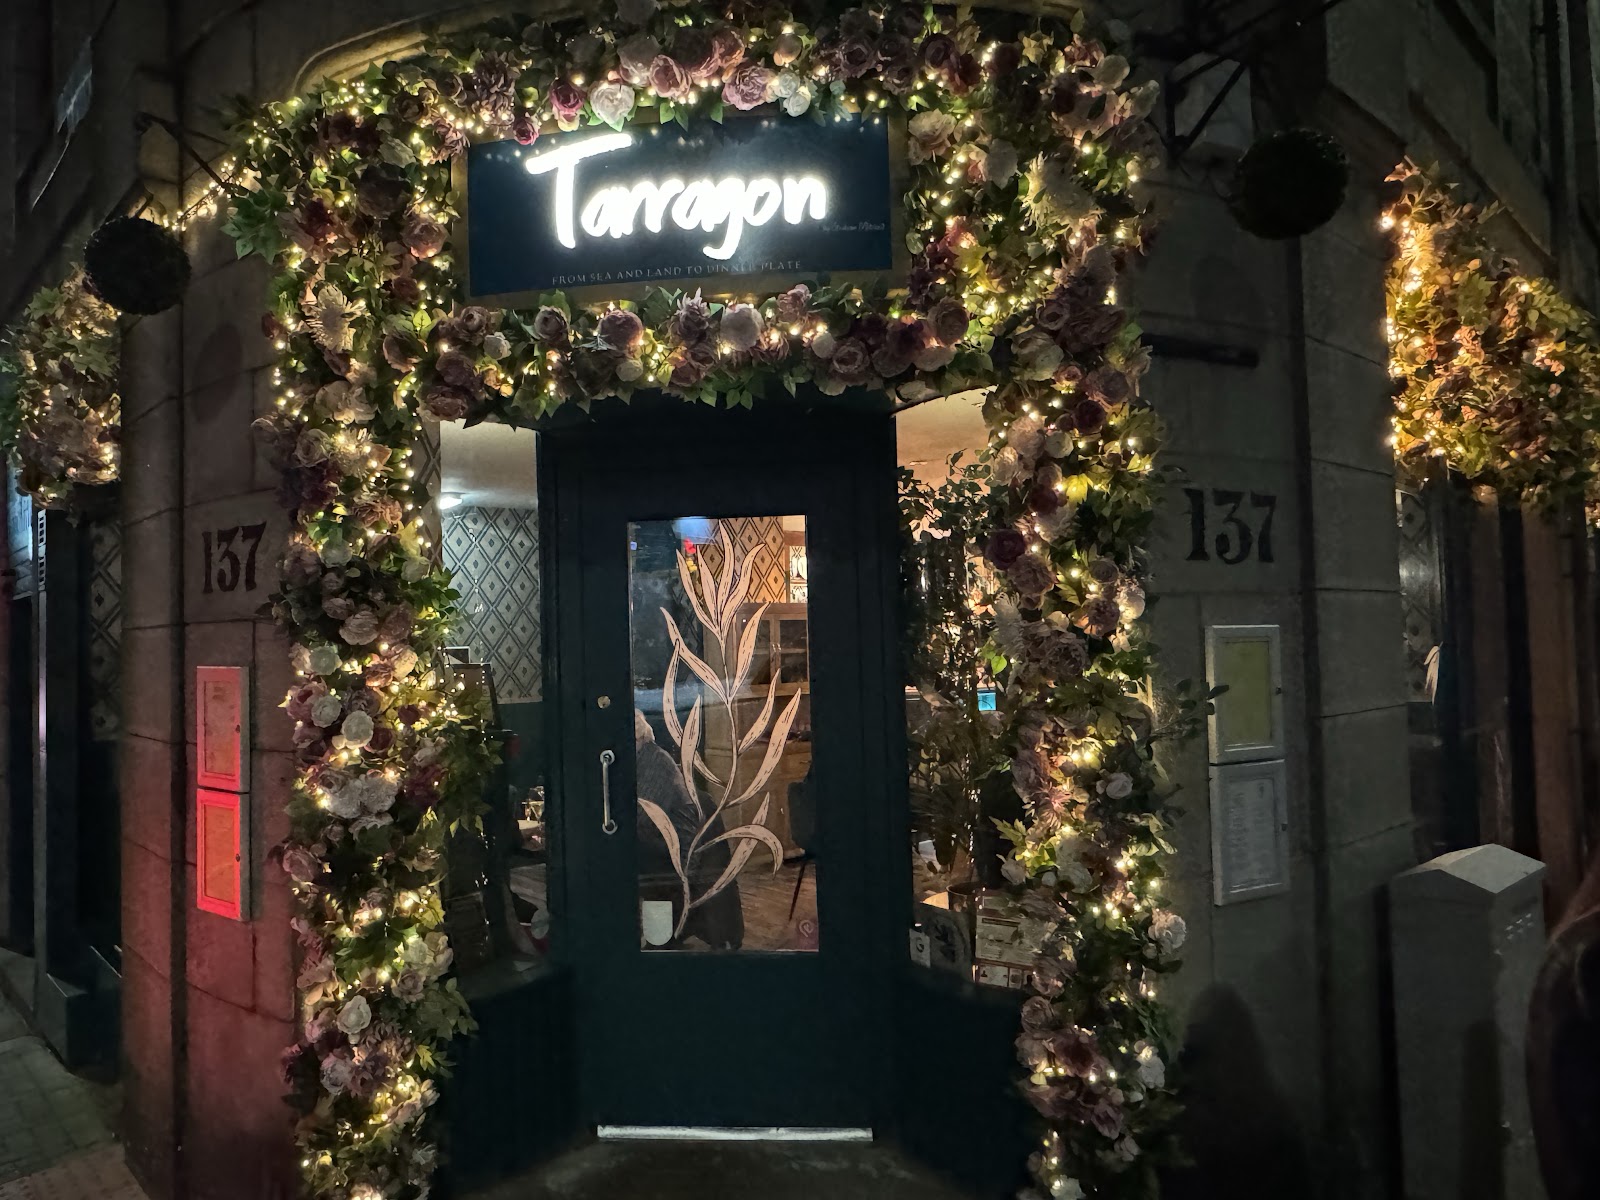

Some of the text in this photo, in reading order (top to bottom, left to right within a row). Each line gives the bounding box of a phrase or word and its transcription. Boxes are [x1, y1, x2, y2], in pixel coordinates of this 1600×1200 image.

[525, 133, 828, 260] Tarragon
[552, 260, 801, 286] FROM SEA AND LAND TO DINNER PLATE
[202, 520, 267, 594] 137
[1182, 487, 1277, 565] 137
